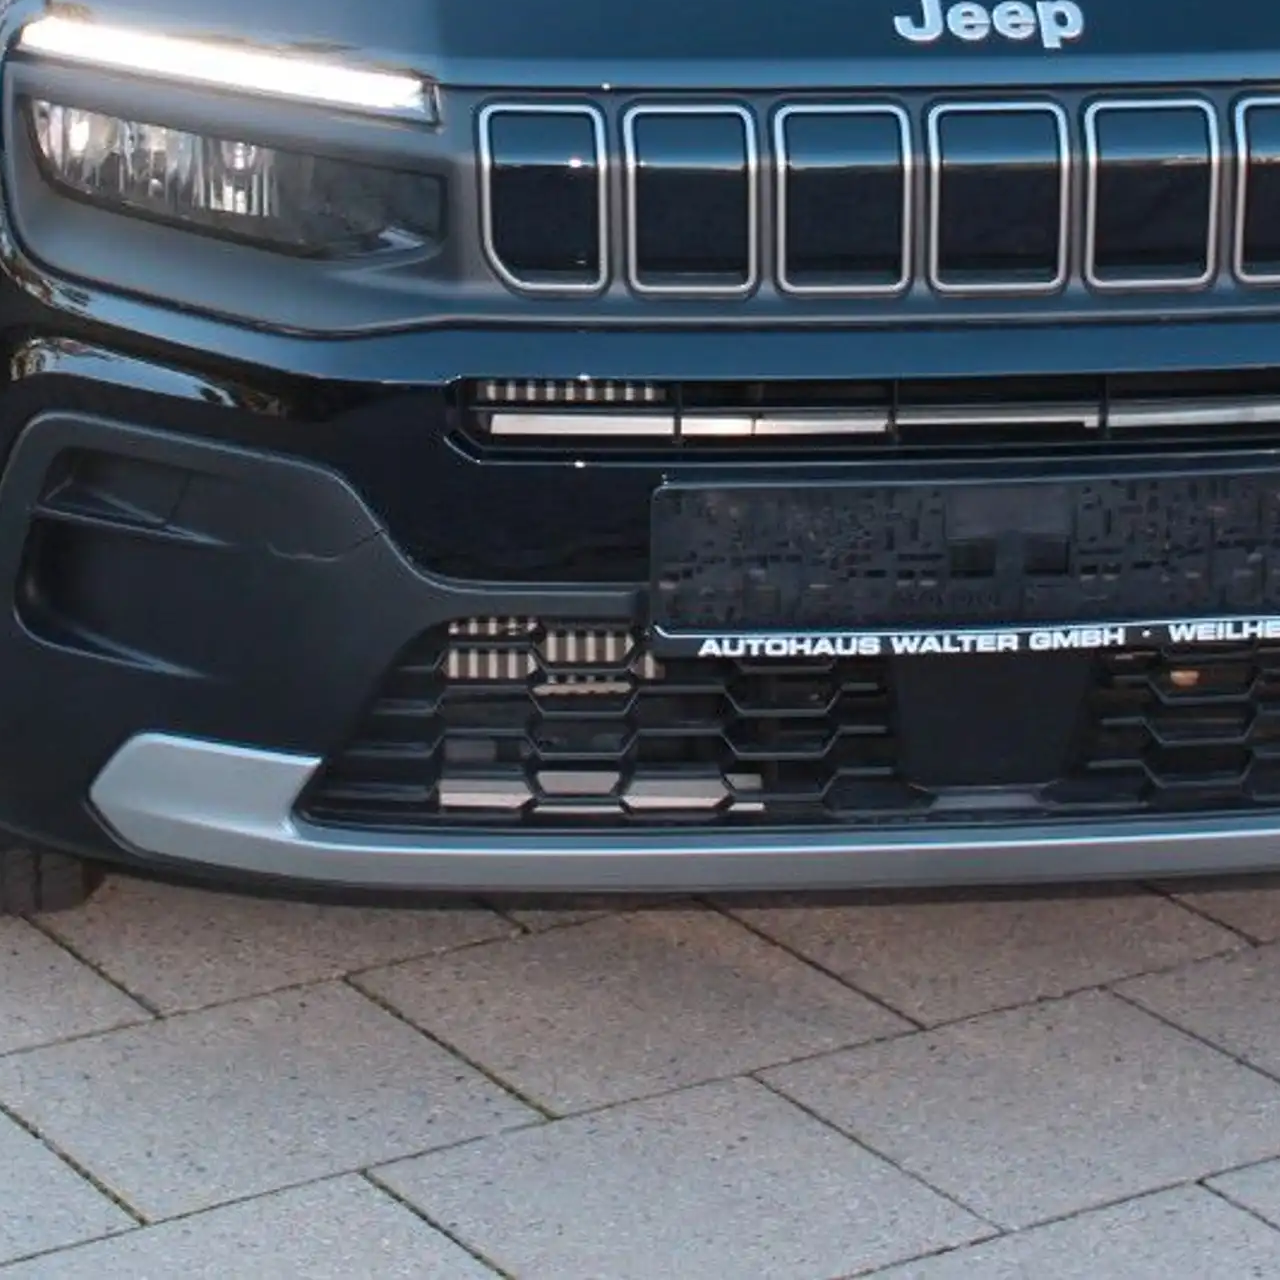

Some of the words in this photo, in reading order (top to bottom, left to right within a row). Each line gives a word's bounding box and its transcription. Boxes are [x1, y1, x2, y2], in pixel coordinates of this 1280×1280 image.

[698, 635, 881, 657] AUTOHAUS
[890, 632, 1019, 654] WALTER
[1028, 627, 1126, 651] GMBH
